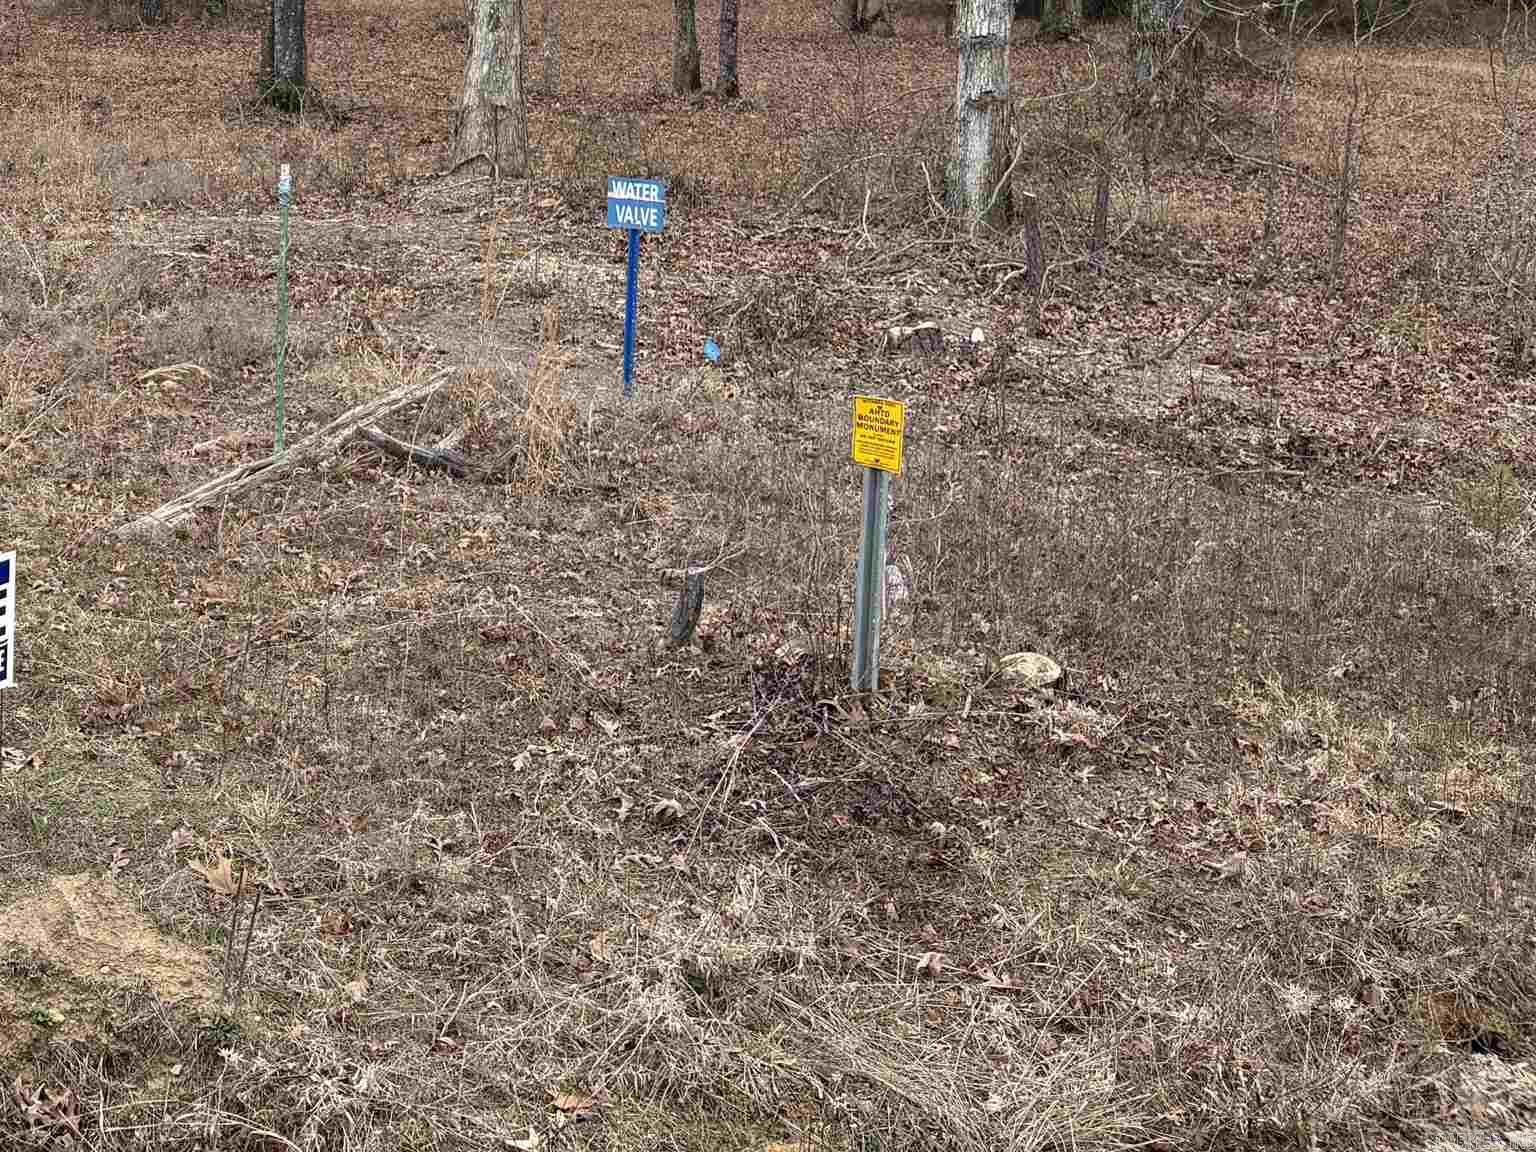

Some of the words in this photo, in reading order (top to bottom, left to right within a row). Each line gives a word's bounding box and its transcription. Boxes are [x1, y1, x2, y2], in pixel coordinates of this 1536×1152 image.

[611, 179, 659, 201] WATER
[615, 204, 658, 227] VALVE
[856, 421, 901, 436] MONUMENT
